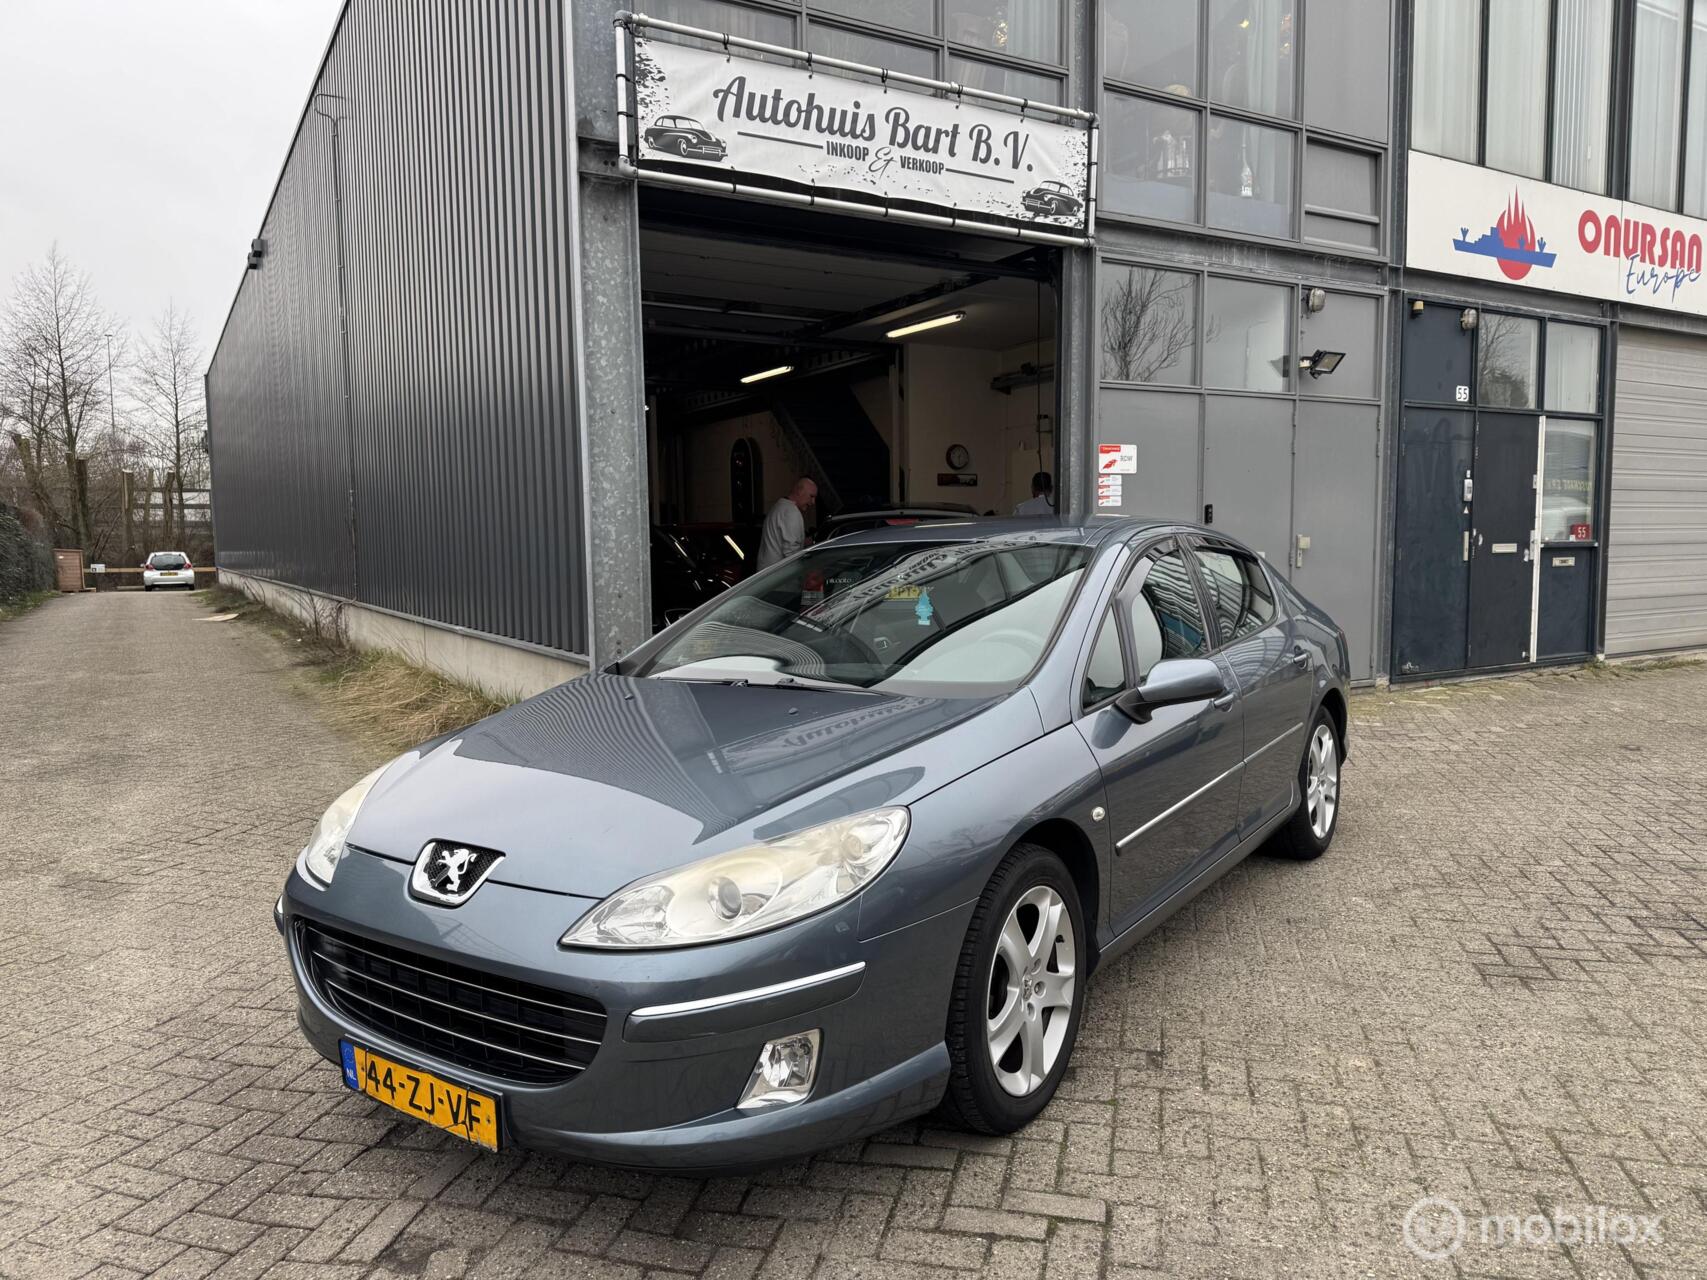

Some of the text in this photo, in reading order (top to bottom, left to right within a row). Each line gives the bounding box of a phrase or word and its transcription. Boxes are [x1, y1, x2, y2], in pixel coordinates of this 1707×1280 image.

[713, 76, 1034, 172] Autohuis Bart B.V.
[826, 140, 945, 180] INKOOP & VERKOOP
[1626, 254, 1701, 303] Europe
[1457, 387, 1468, 400] 55
[1577, 526, 1586, 538] 55
[346, 1068, 357, 1081] NL
[367, 1060, 481, 1132] 44-ZJ-VF
